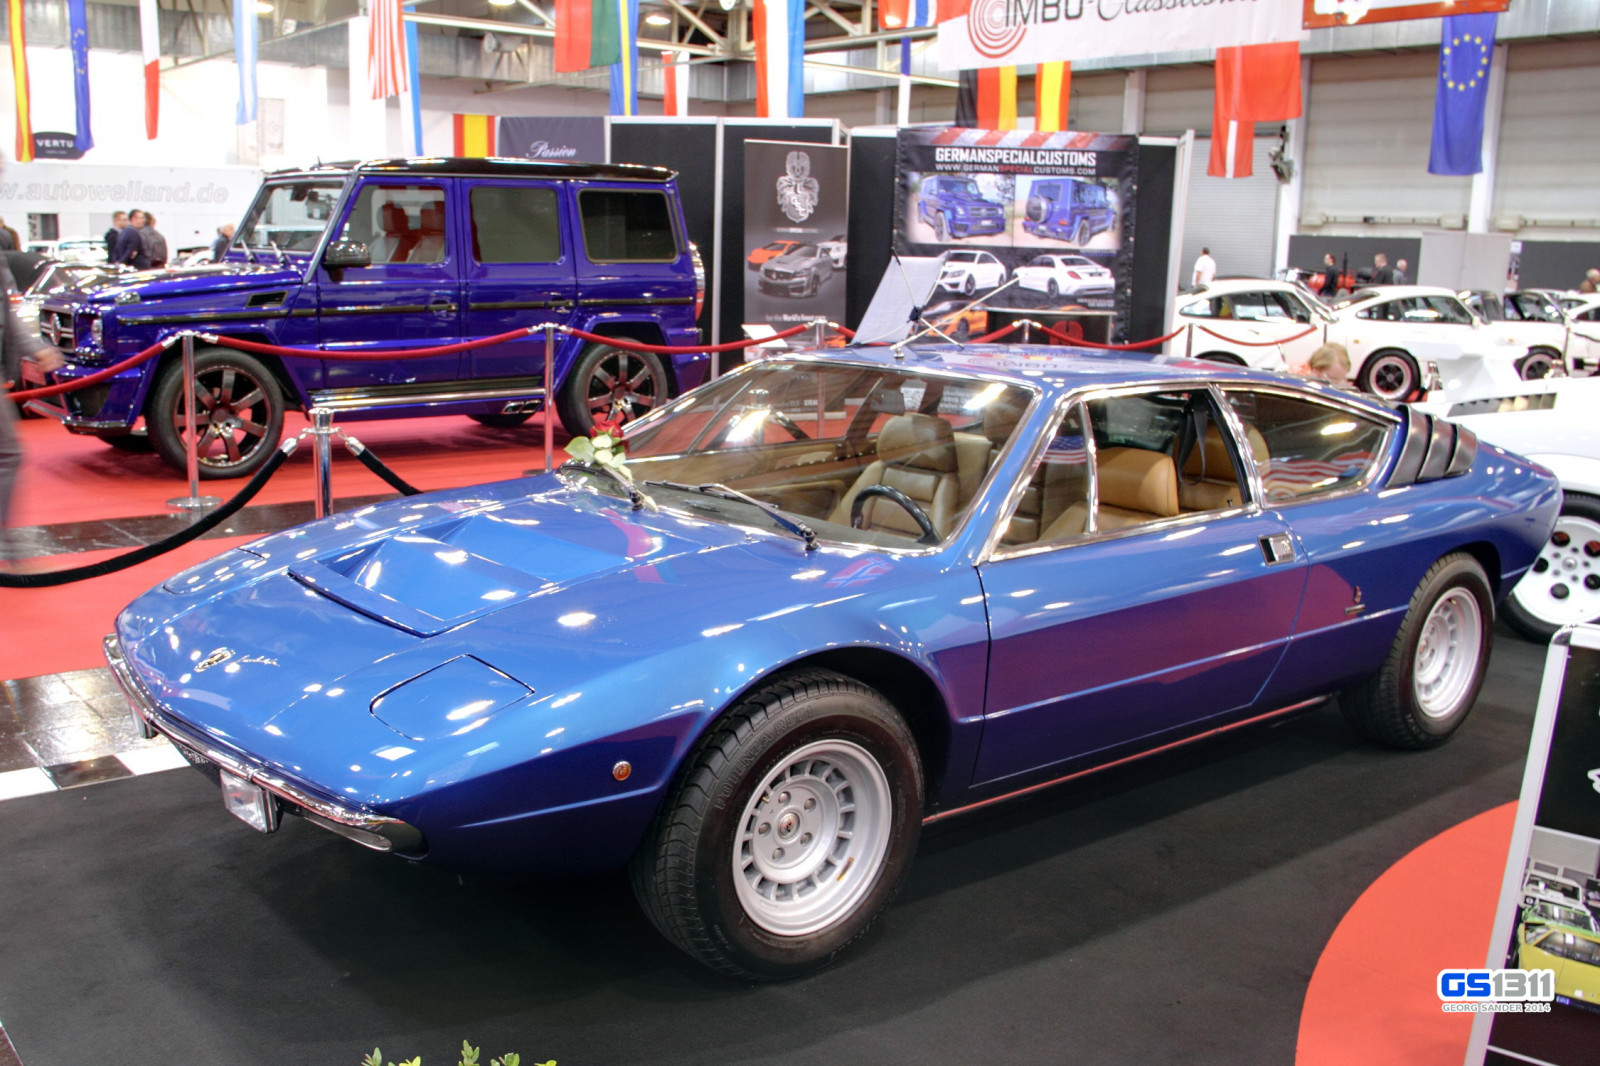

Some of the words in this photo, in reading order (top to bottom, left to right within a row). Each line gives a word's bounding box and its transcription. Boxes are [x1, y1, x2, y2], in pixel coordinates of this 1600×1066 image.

[36, 138, 74, 148] VERTU
[525, 140, 577, 158] Passion
[935, 147, 1097, 166] GERMANSPECIALCUSTOMS
[935, 164, 1097, 176] WWW.GERMANSPECIALCUSTOMS.COM
[713, 734, 774, 811] POTENZA
